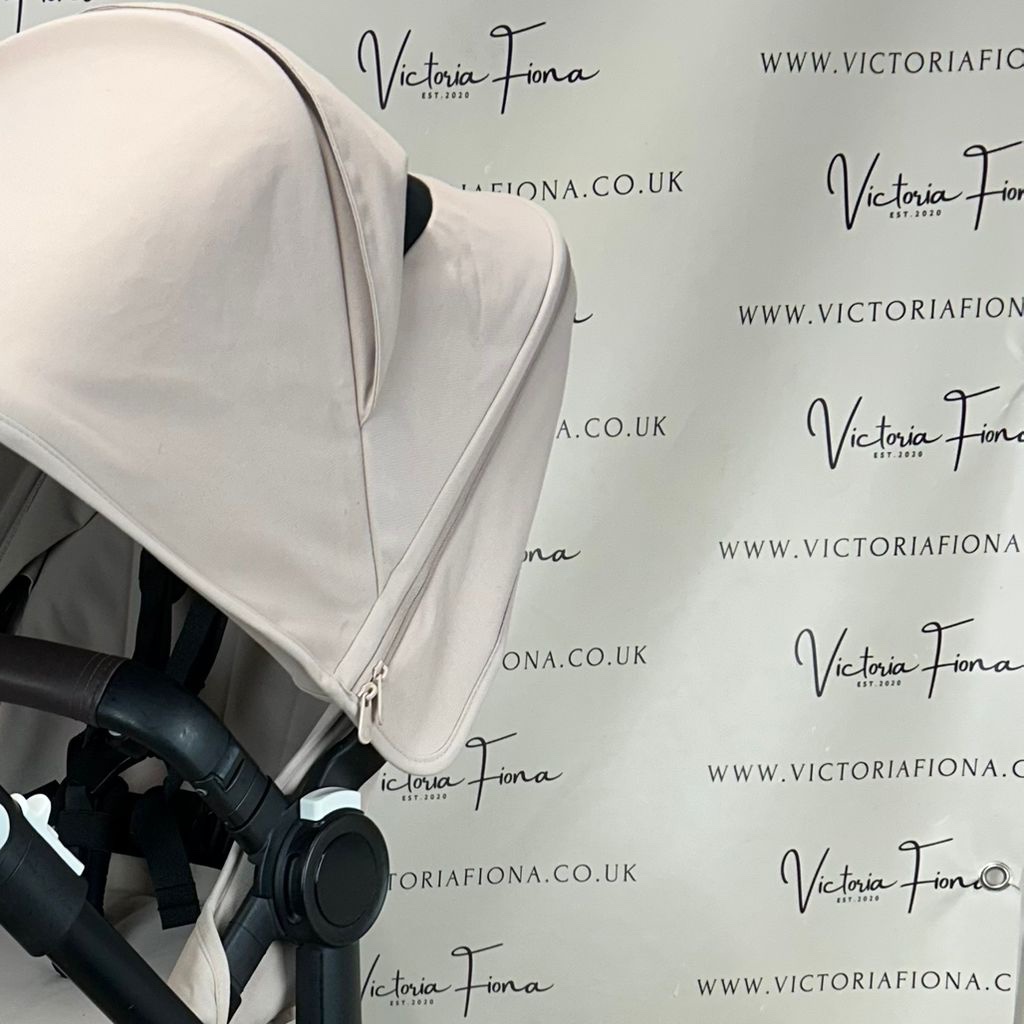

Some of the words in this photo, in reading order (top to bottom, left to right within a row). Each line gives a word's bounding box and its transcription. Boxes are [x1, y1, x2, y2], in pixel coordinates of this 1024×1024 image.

[358, 29, 489, 110] Victoria
[490, 21, 600, 115] Fiona
[761, 48, 1024, 74] WWW.VICTORIAFIO
[421, 91, 470, 99] EST.2020
[827, 153, 963, 230] Victoria
[889, 209, 942, 218] EST.2020
[739, 297, 1024, 325] WWW.VICTORIAFION
[807, 396, 943, 470] Victoria
[794, 627, 919, 698] Victoria
[921, 618, 1024, 699] Fiona
[381, 772, 465, 792] ictoria
[465, 732, 563, 811] Fiona
[708, 757, 1024, 783] WWW.VICTORIAFIONA.C
[388, 863, 638, 891] TORIAFIONA.CO.UK
[781, 848, 897, 914] Victoria
[451, 943, 554, 1017] Fiona
